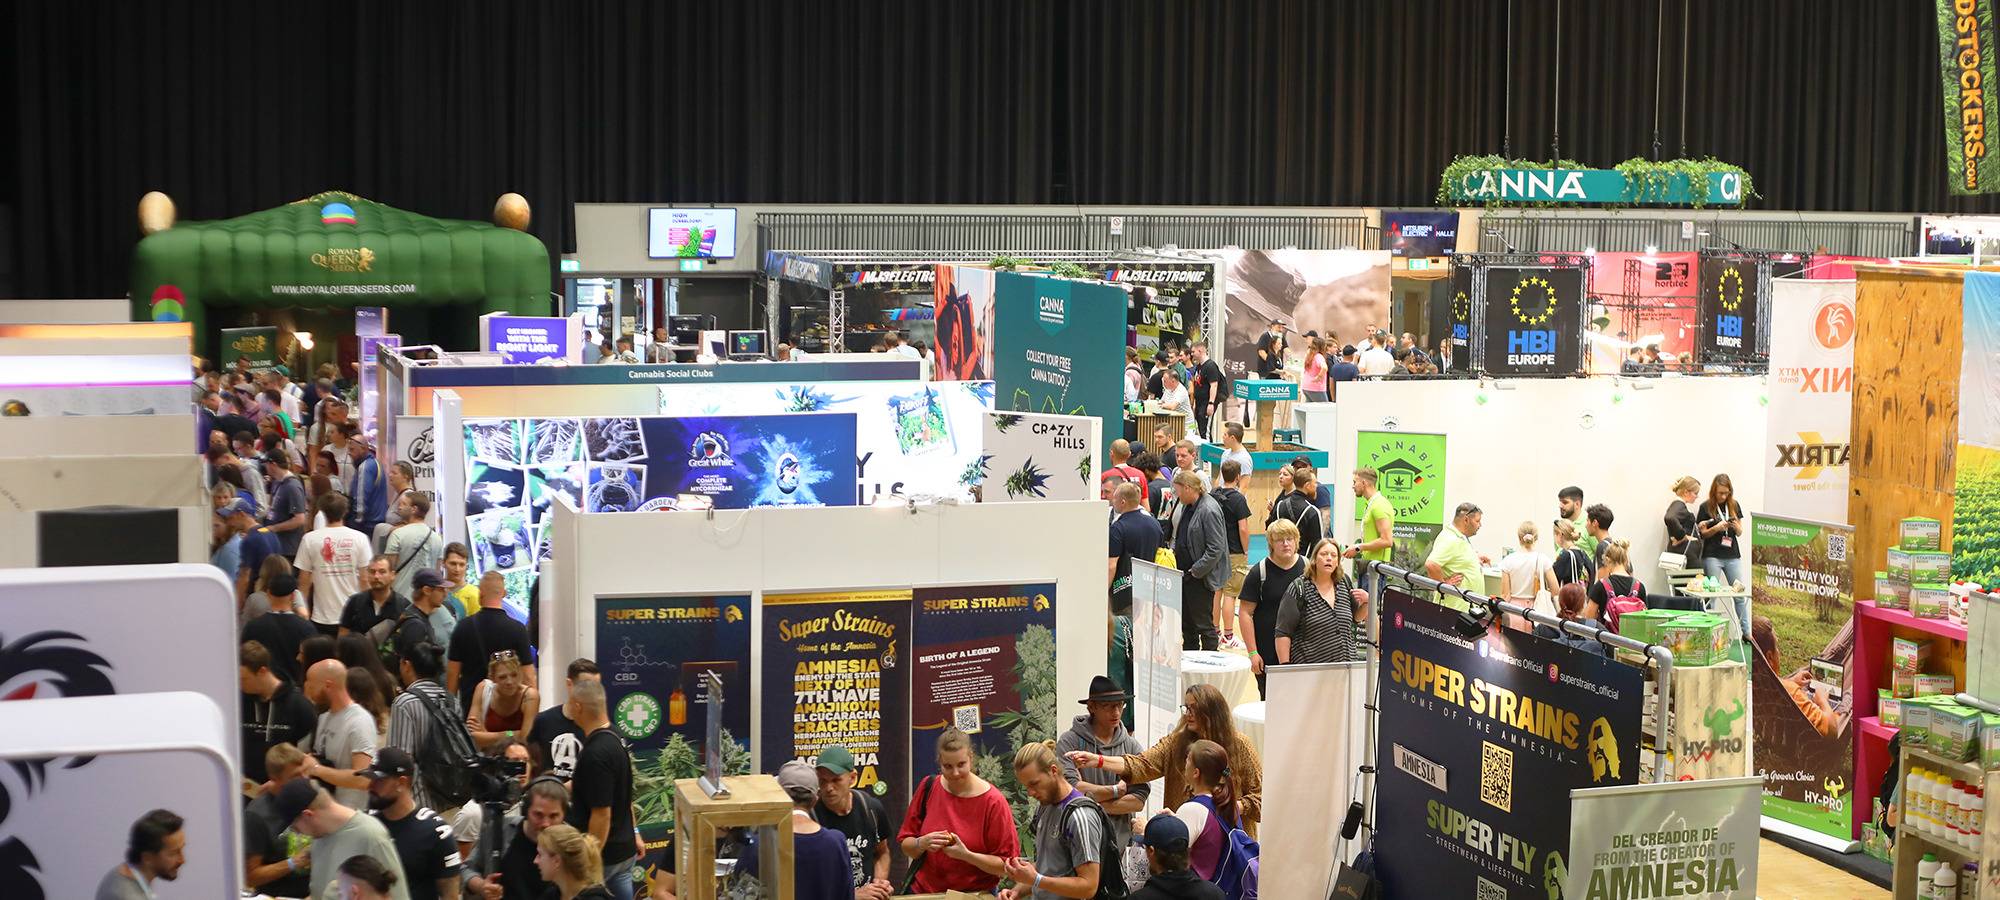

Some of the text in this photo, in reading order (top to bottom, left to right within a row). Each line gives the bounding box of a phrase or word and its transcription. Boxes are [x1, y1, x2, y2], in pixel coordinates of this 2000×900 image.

[1463, 171, 1586, 199] CANNA
[311, 253, 360, 267] QUEEN
[272, 284, 416, 295] WWW.ROYALQUEENSEEDS.COM
[1040, 297, 1064, 313] CANNA
[1453, 324, 1467, 339] HBI
[1717, 314, 1743, 337] HBI
[1508, 330, 1555, 353] HBI
[1716, 336, 1742, 348] EUROPE
[1026, 349, 1071, 370] COLLECT YOUR FREE
[1508, 354, 1555, 365] EUROPE
[628, 369, 714, 378] Cannabis Social Clubs
[1031, 368, 1066, 387] CANNA TATTOO
[1032, 423, 1074, 436] CRAZY
[1053, 437, 1085, 449] HILLS
[688, 458, 733, 467] Great White
[1364, 441, 1437, 480] ANNABIS
[1766, 564, 1839, 586] WHICH WAY YOU
[1765, 575, 1840, 598] WANT TO GROW?
[923, 596, 1030, 610] SUPER STRAINS
[606, 607, 720, 620] SUPER STRAINS
[779, 609, 896, 641] Super Strains
[820, 642, 829, 654] of
[830, 642, 841, 651] the
[920, 654, 945, 663] BIRTH
[946, 651, 959, 660] OF
[967, 646, 1000, 656] LEGEND
[795, 659, 880, 675] AMNESIA
[1522, 658, 1544, 675] Official
[614, 673, 638, 681] CBD
[795, 678, 880, 691] NEXT OF KIN
[1560, 672, 1619, 700] superstrains_official
[618, 695, 658, 713] CBD STRAIN
[794, 688, 880, 704] 7TH WAVE
[1391, 649, 1580, 750] SUPER STRAINS
[794, 701, 880, 713] AMAJIKOYM
[794, 711, 881, 722] EL CUCARACHA
[618, 718, 658, 736] CBD STRAIN
[794, 719, 880, 733] CRACKERS
[1402, 691, 1563, 762] HOME OF THE AMNESIA
[1682, 738, 1742, 756] HY-PRO
[1402, 752, 1436, 784] AMNESIA
[1795, 770, 1815, 781] Choice
[1804, 790, 1843, 812] HY-PRO
[1426, 799, 1537, 875] SUPER FLY
[1613, 827, 1719, 848] DEL CREADOR DE
[1435, 836, 1479, 863] STREETWEAR
[1488, 862, 1524, 886] LIFESTYLE
[1594, 842, 1736, 867] FROM THE CREATOR OF
[1585, 857, 1739, 900] AMNESIA
